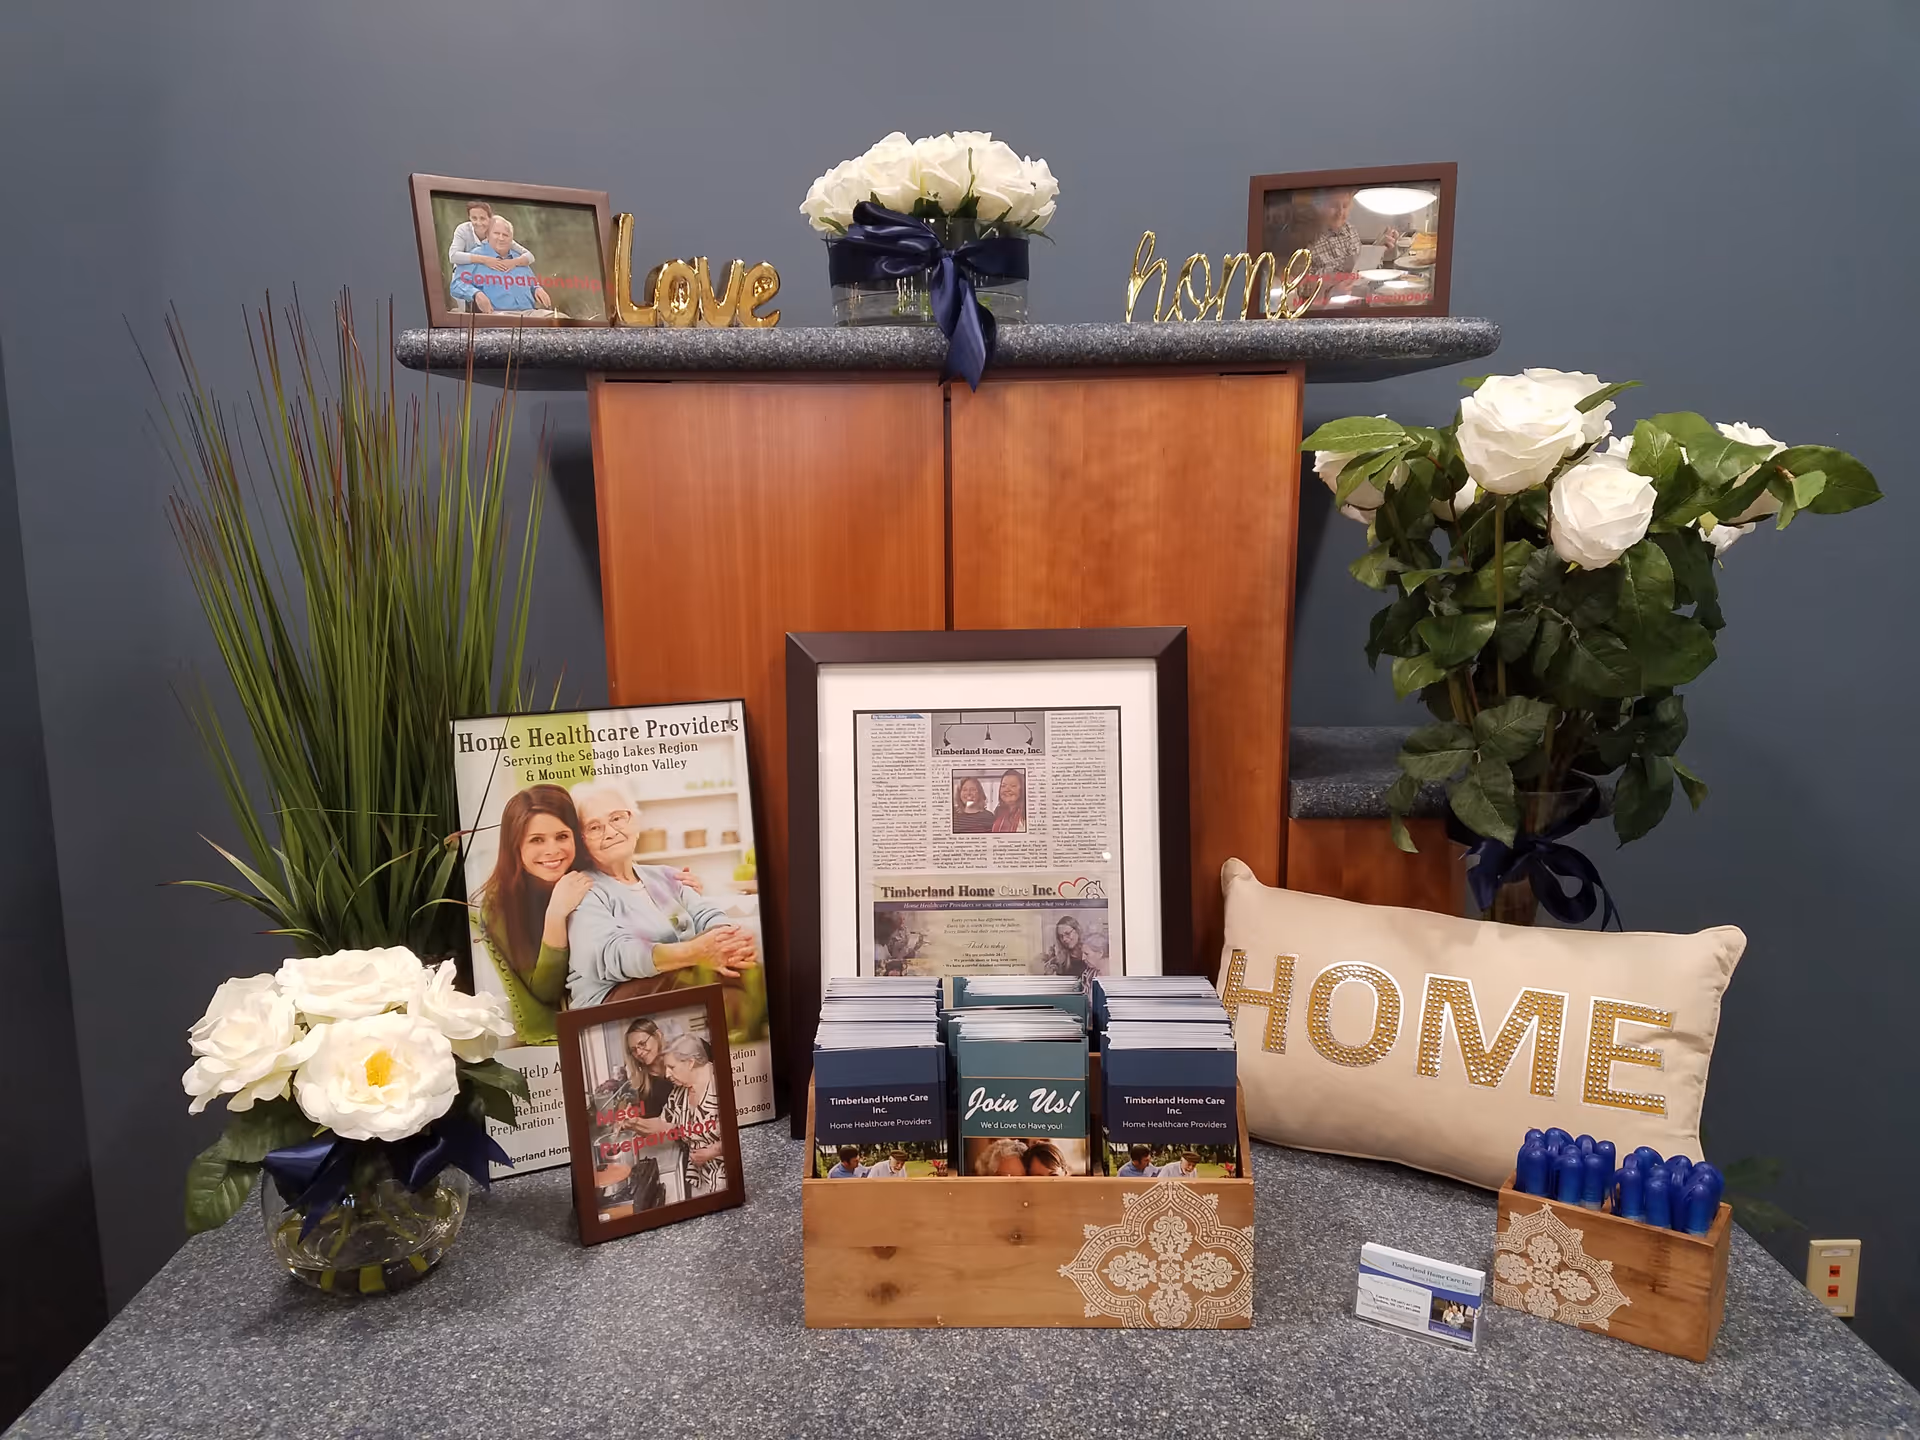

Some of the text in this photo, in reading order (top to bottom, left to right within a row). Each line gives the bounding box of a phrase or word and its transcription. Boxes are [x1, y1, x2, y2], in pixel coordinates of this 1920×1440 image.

[611, 211, 781, 328] Love
[1125, 230, 1323, 323] home
[457, 715, 739, 753] Home Healthcare Providers
[503, 742, 698, 767] Serving the Sebago Lakes Region
[538, 768, 576, 781] Mount
[579, 762, 648, 777] Washington
[652, 758, 687, 770] Valley
[880, 884, 1056, 898] Timberland Home Care Inc.
[1221, 948, 1678, 1119] HOME
[519, 1064, 549, 1079] Help
[731, 1062, 745, 1074] eal
[744, 1073, 768, 1085] Long
[829, 1094, 929, 1106] Timberland Home Care
[964, 1086, 1081, 1120] Join Us!
[1124, 1096, 1226, 1105] Timberland Home Care
[596, 1100, 646, 1126] Meal
[872, 1106, 888, 1114] Inc.
[490, 1117, 554, 1136] Preparation
[854, 1119, 895, 1128] Healthcare
[896, 1118, 932, 1126] Providers
[980, 1121, 999, 1129] We'd
[1000, 1121, 1017, 1129] Love
[1018, 1121, 1027, 1129] to
[1047, 1123, 1063, 1131] you!
[1147, 1120, 1189, 1128] Healthcare
[600, 1119, 717, 1158] Preparation
[1392, 1261, 1426, 1275] Timberland
[1427, 1270, 1446, 1280] Home
[1446, 1275, 1460, 1284] Care
